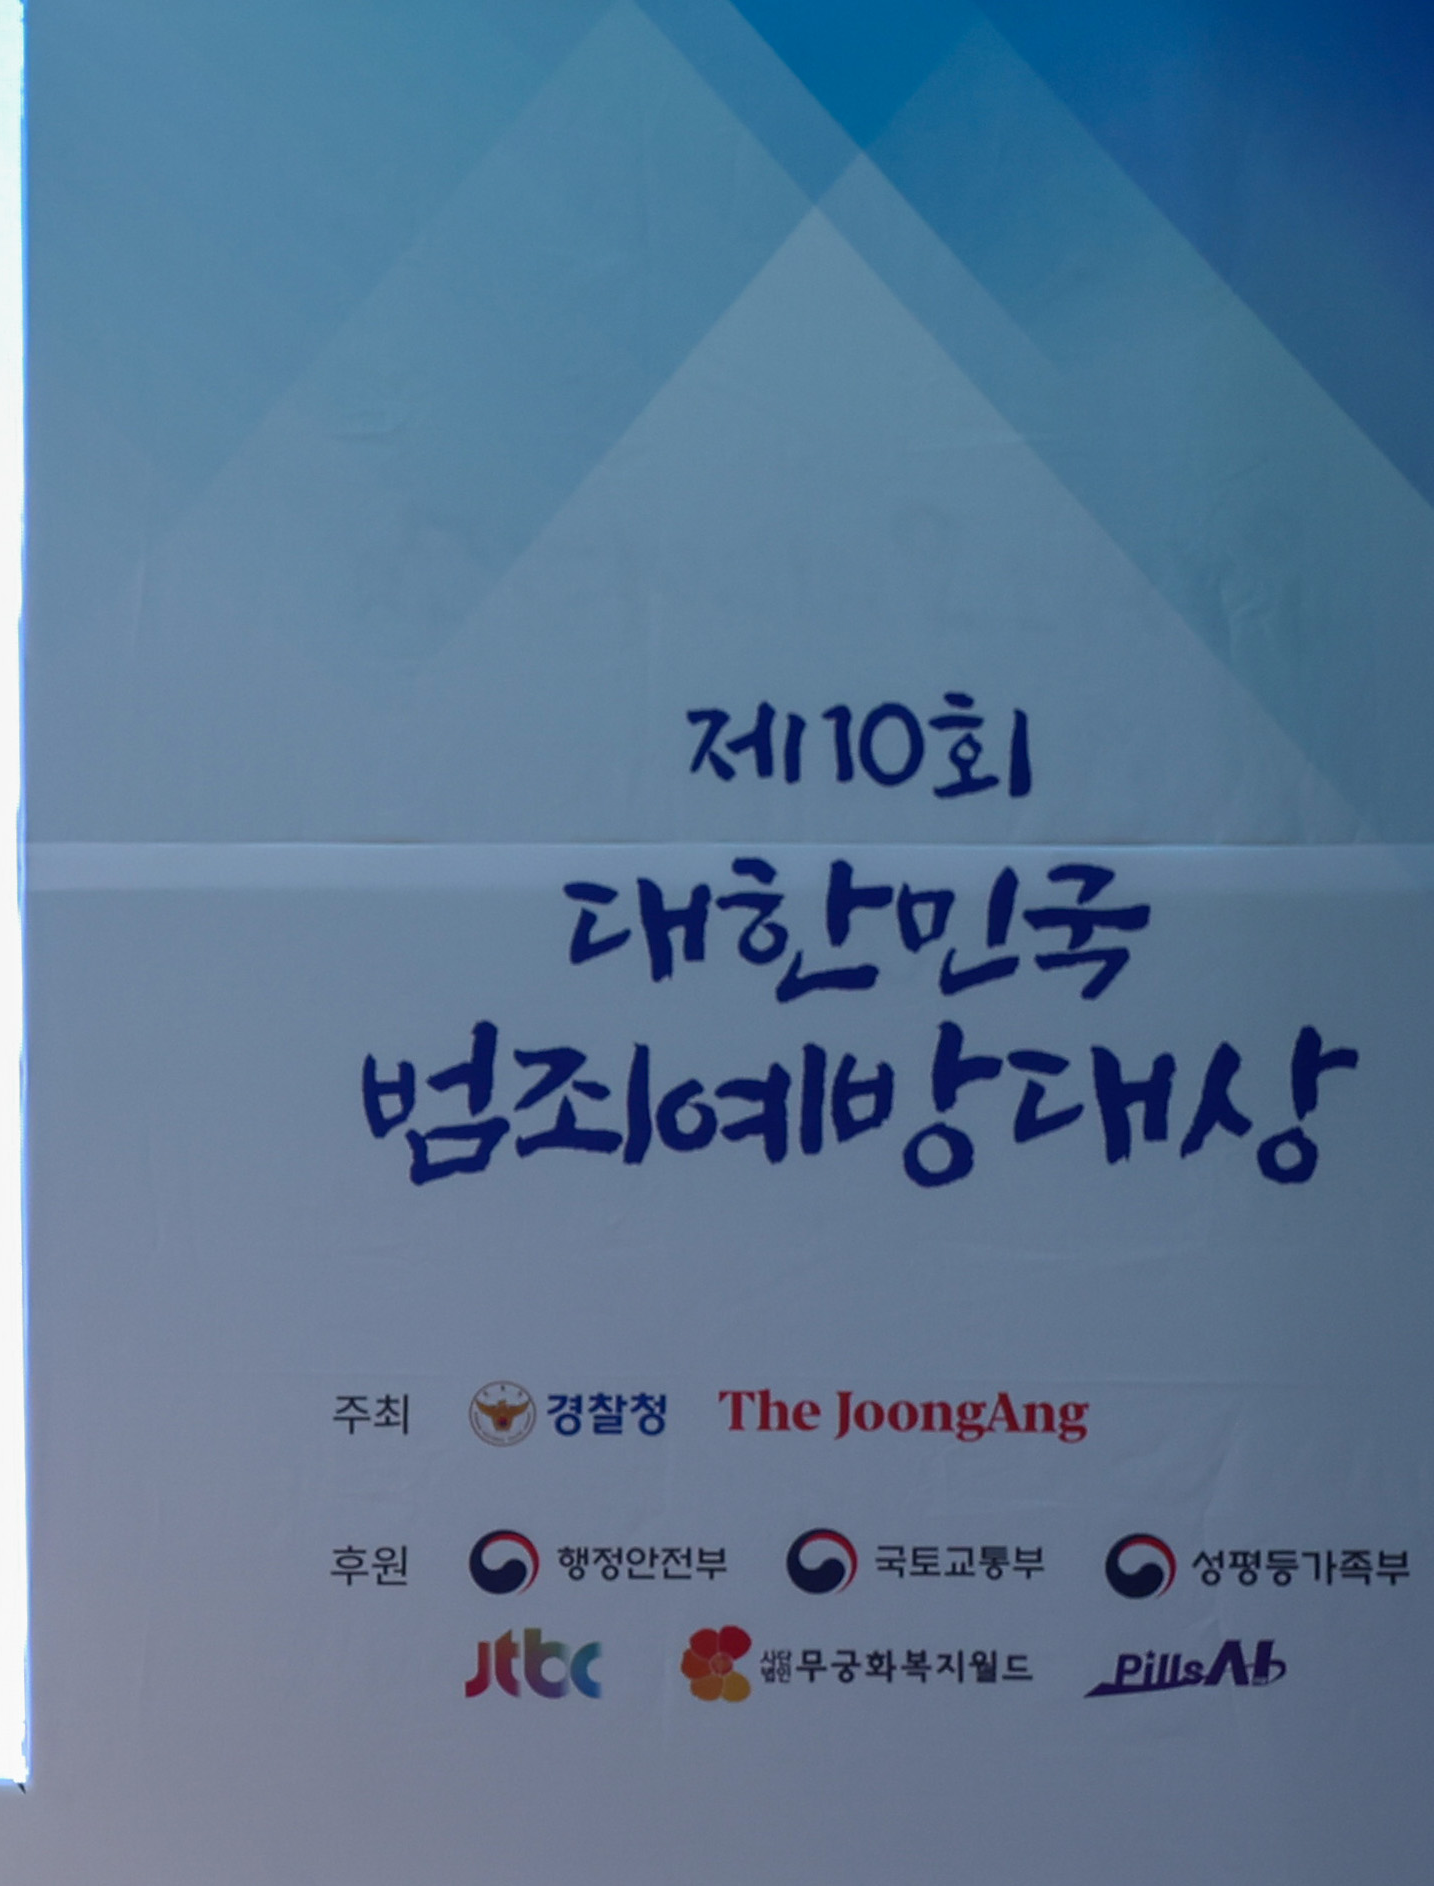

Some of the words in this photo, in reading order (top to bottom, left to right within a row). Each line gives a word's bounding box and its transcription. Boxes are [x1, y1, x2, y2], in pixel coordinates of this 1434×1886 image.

[686, 691, 1033, 800] 제10회
[563, 857, 1152, 1003] 대한민국
[362, 1020, 1360, 1188] 범죄예방대상
[332, 1393, 409, 1436] 주최
[547, 1392, 667, 1437] 경찰청
[719, 1389, 822, 1432] The
[836, 1391, 1090, 1444] JoongAng
[330, 1545, 408, 1586] 후원
[557, 1546, 727, 1582] 행정안전부
[876, 1545, 1045, 1581] 국토교통부
[1192, 1549, 1410, 1587] 성평등가족부
[796, 1649, 1034, 1683] 무궁화복지월드
